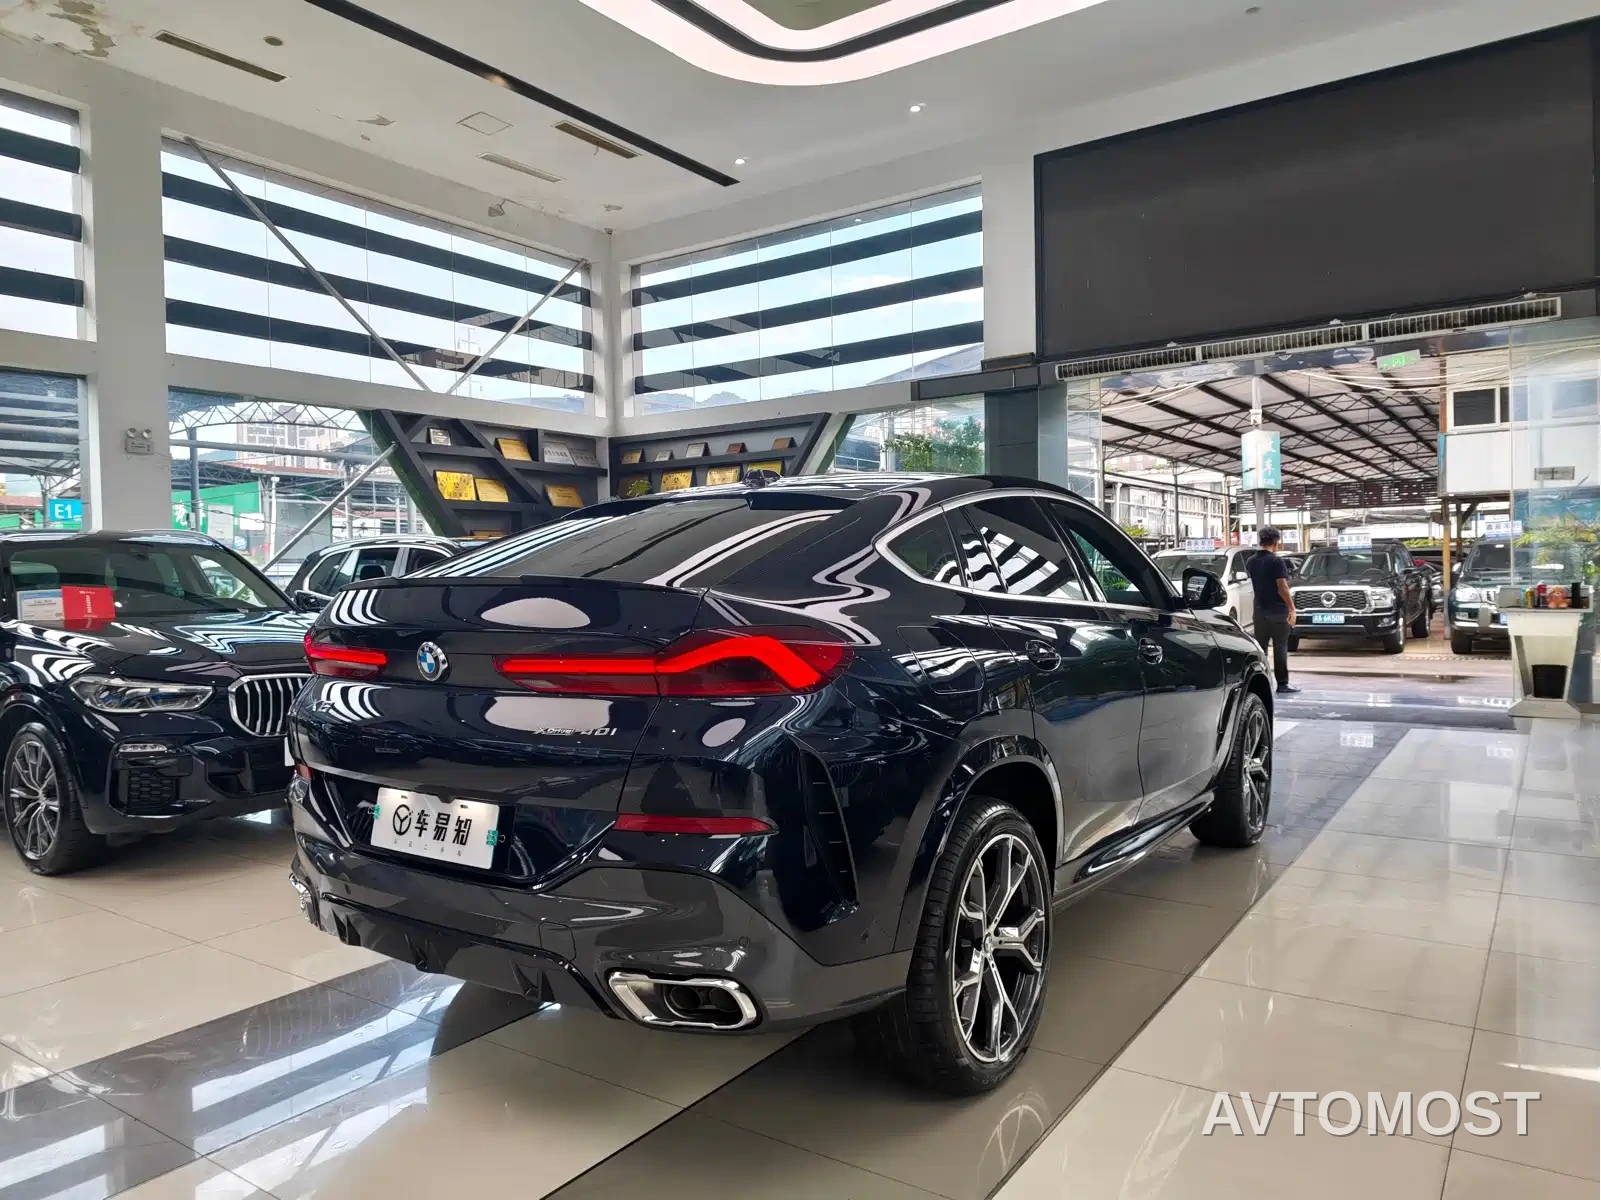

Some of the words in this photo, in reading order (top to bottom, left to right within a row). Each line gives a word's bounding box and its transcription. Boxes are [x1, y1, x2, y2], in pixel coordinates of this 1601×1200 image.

[54, 503, 73, 519] E1
[414, 809, 473, 846] 车易知
